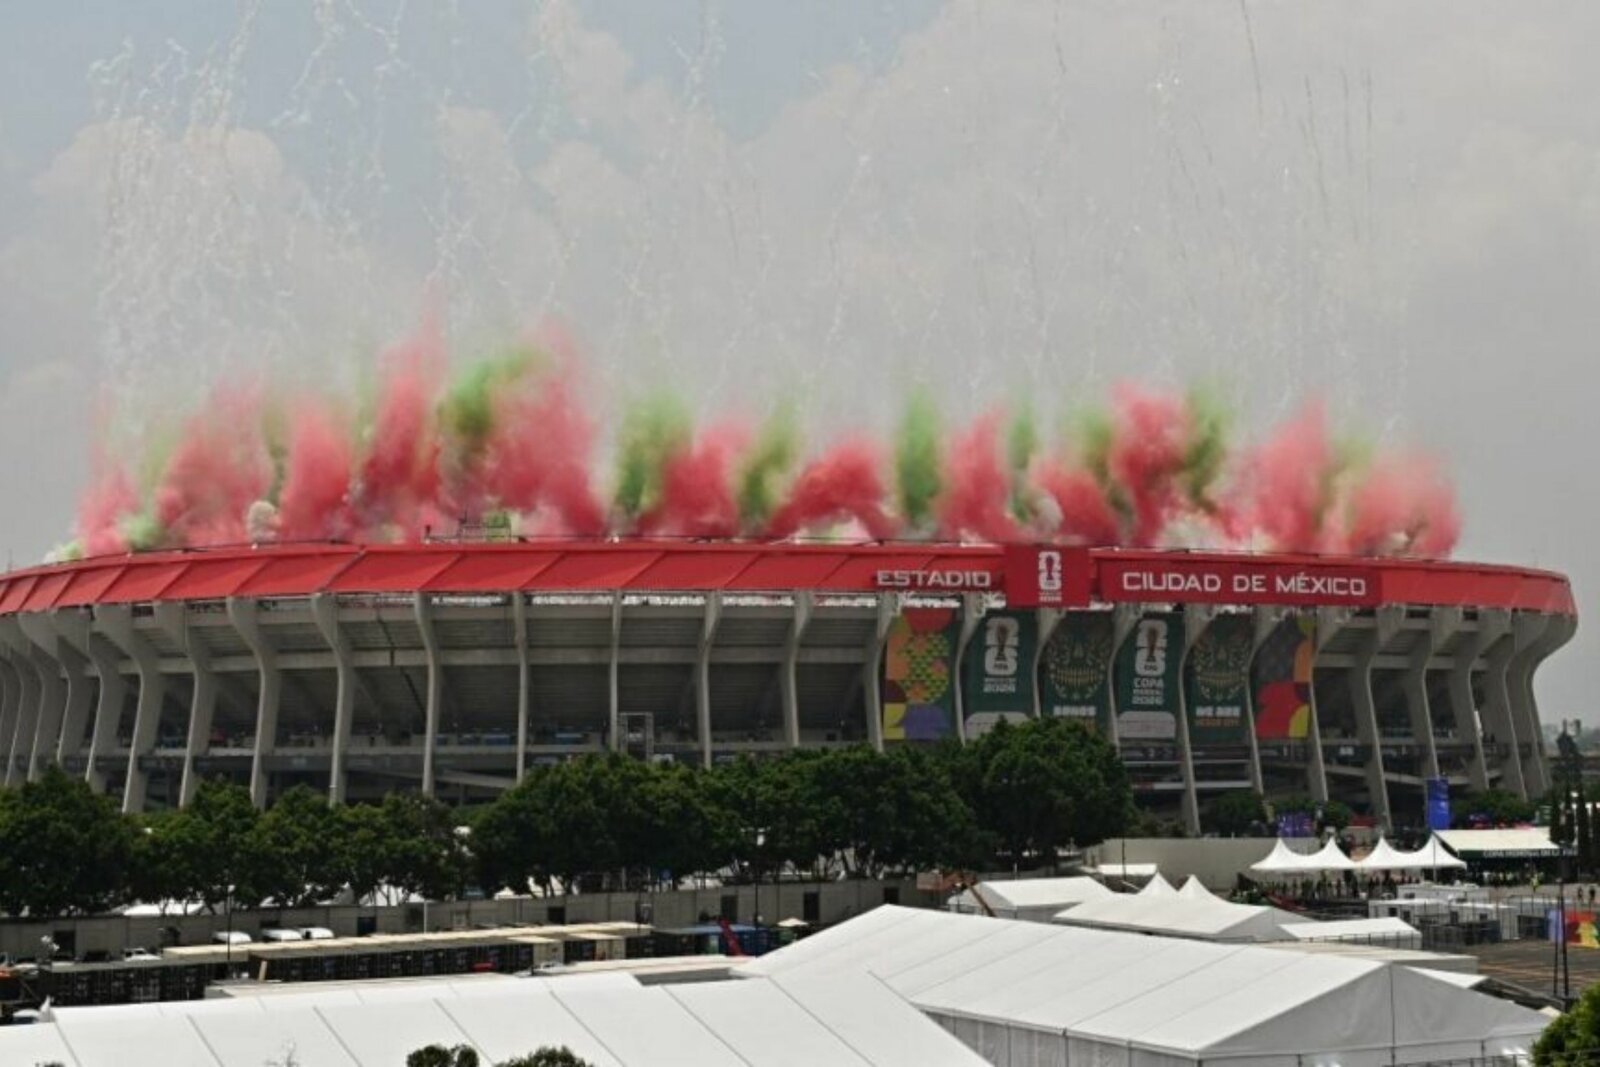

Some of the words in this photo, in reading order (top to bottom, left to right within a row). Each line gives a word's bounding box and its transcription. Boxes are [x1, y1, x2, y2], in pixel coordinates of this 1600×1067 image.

[877, 570, 991, 587] ESTADIO
[1122, 572, 1221, 592] CIUDAD
[1232, 575, 1267, 593] DE
[1275, 573, 1366, 595] MÉXICO
[983, 684, 1016, 694] 2026
[1133, 677, 1165, 688] COPA
